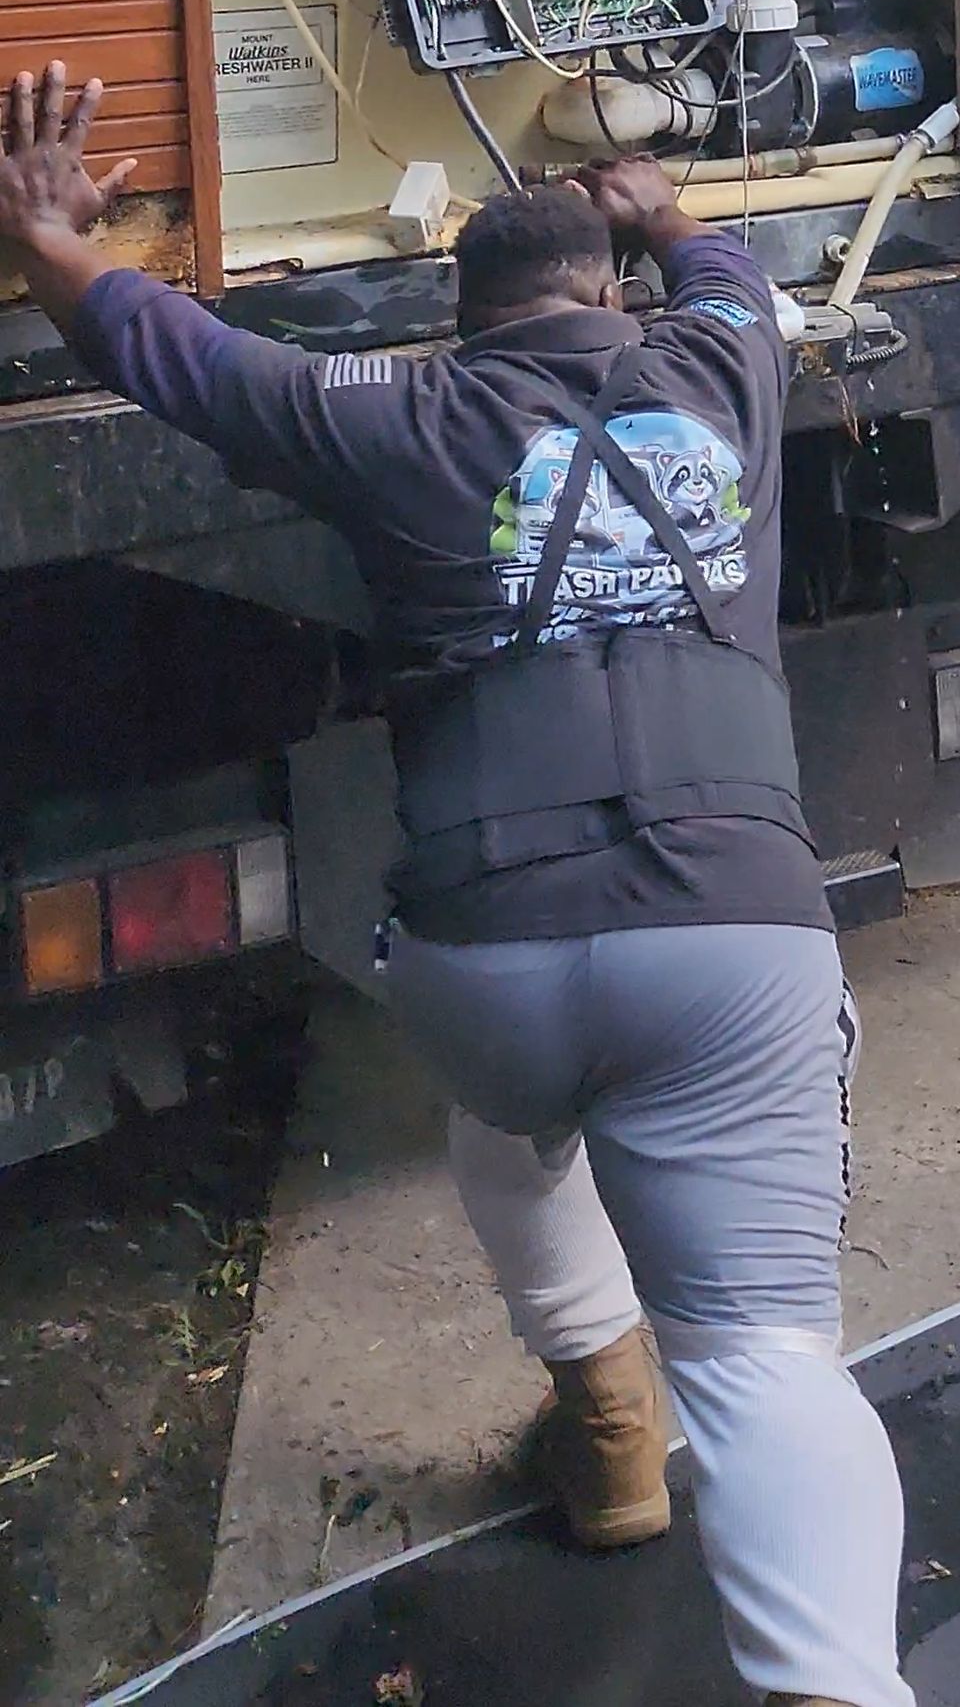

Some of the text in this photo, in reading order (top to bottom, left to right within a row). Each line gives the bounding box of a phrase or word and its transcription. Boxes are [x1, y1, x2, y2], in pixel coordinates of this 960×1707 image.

[242, 34, 273, 44] MOUNT
[228, 45, 289, 61] Watkins
[214, 57, 301, 76] RESHWATER
[246, 75, 271, 84] HERE
[500, 569, 617, 605] TASH
